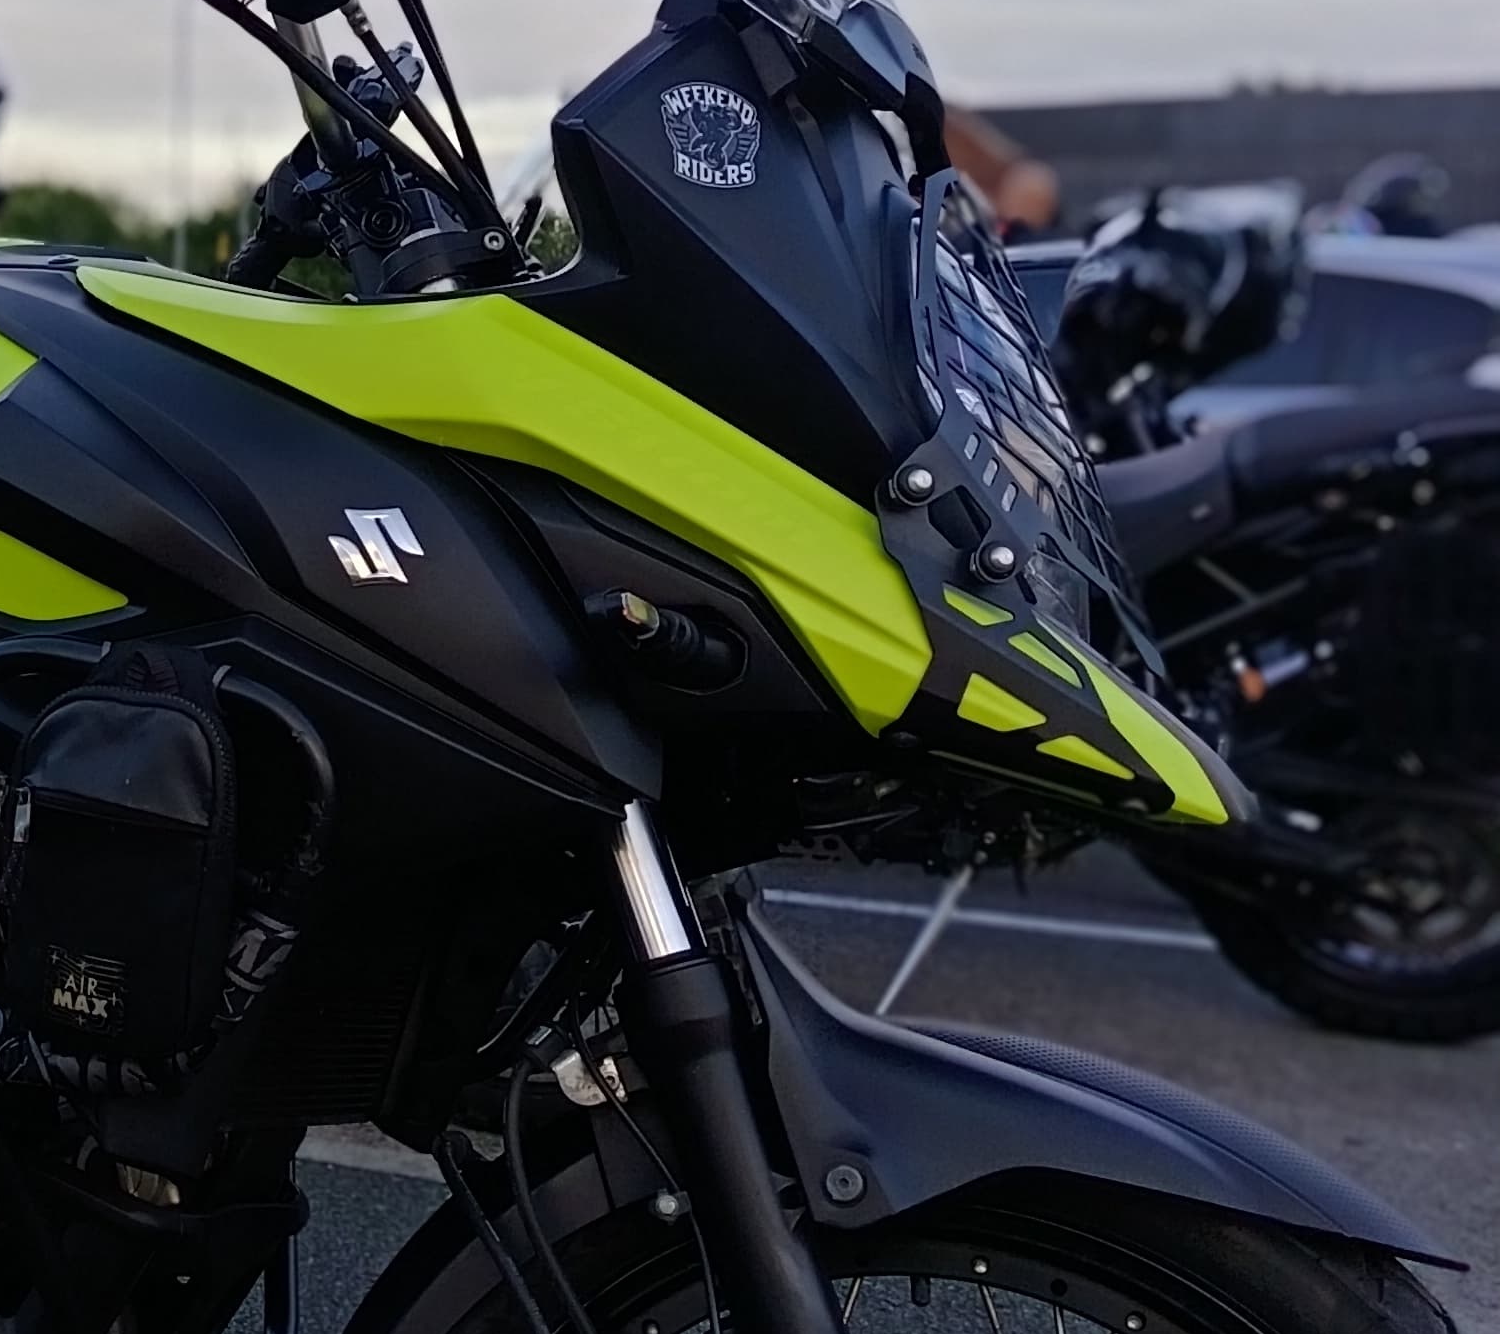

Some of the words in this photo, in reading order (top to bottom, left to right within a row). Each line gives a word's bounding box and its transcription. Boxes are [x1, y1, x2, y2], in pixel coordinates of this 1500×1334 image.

[664, 85, 754, 125] WEEKEND
[677, 152, 753, 185] RIDERS
[64, 974, 98, 996] AIR
[53, 988, 108, 1017] MAX
